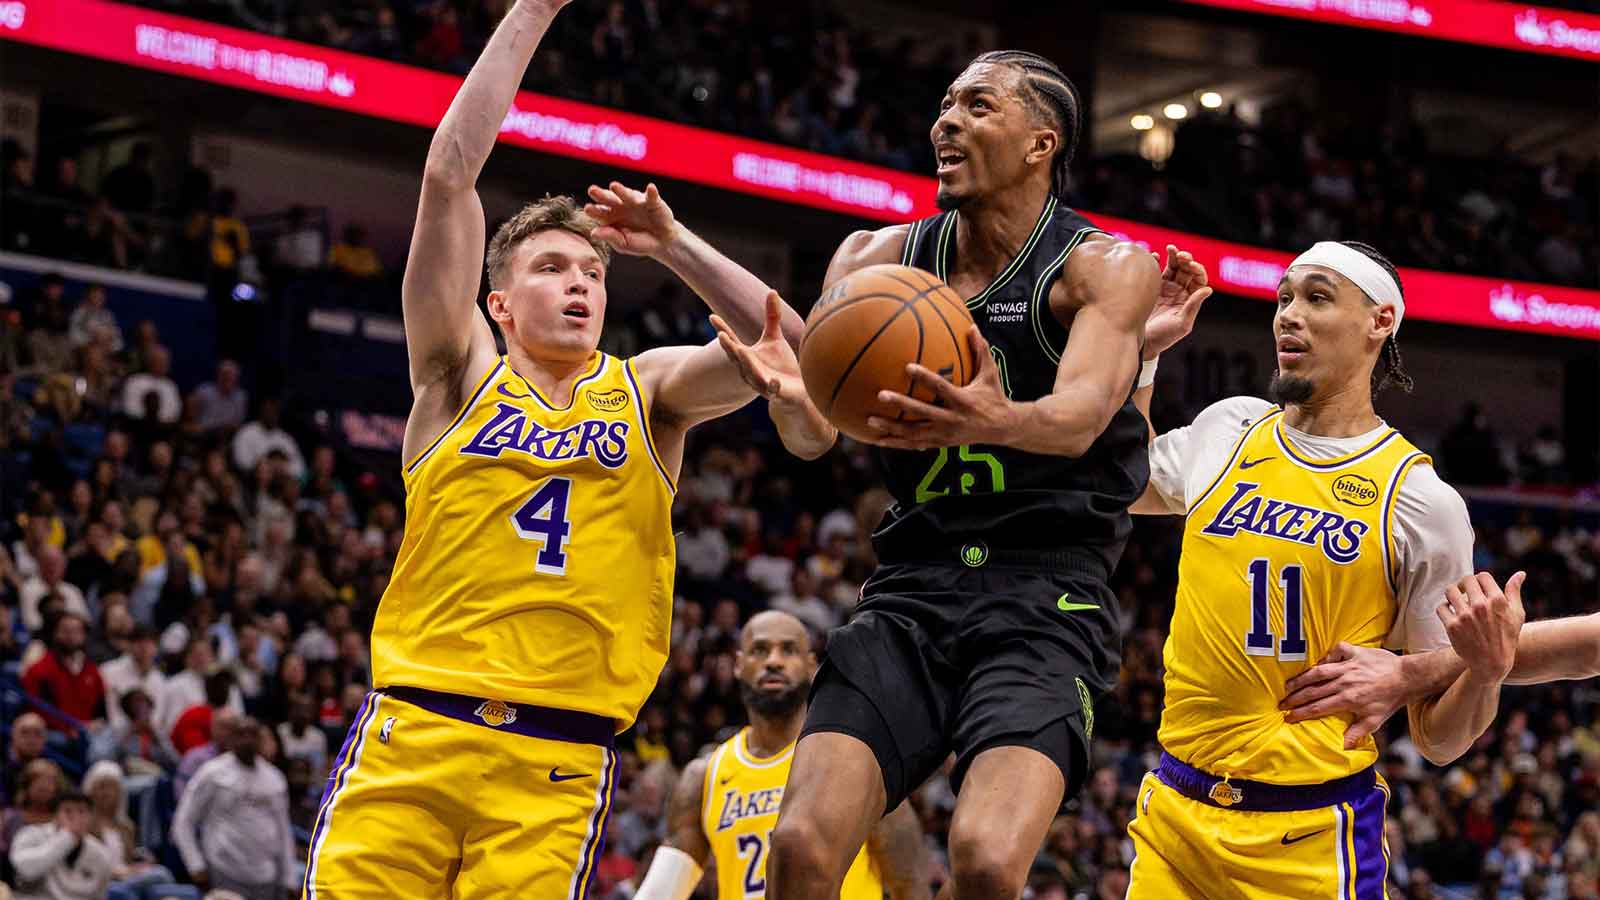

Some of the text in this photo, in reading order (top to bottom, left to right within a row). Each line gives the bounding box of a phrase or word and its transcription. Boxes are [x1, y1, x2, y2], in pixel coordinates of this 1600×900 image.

[986, 301, 1028, 314] NEWAGE
[989, 314, 1024, 323] PRODUCTS
[459, 402, 630, 469] LAKERS
[1200, 480, 1370, 565] LAKERS
[1336, 479, 1376, 500] bibigo
[509, 475, 574, 577] 4
[1244, 557, 1309, 662] 11
[716, 787, 785, 833] LAKE
[736, 830, 775, 899] 2
